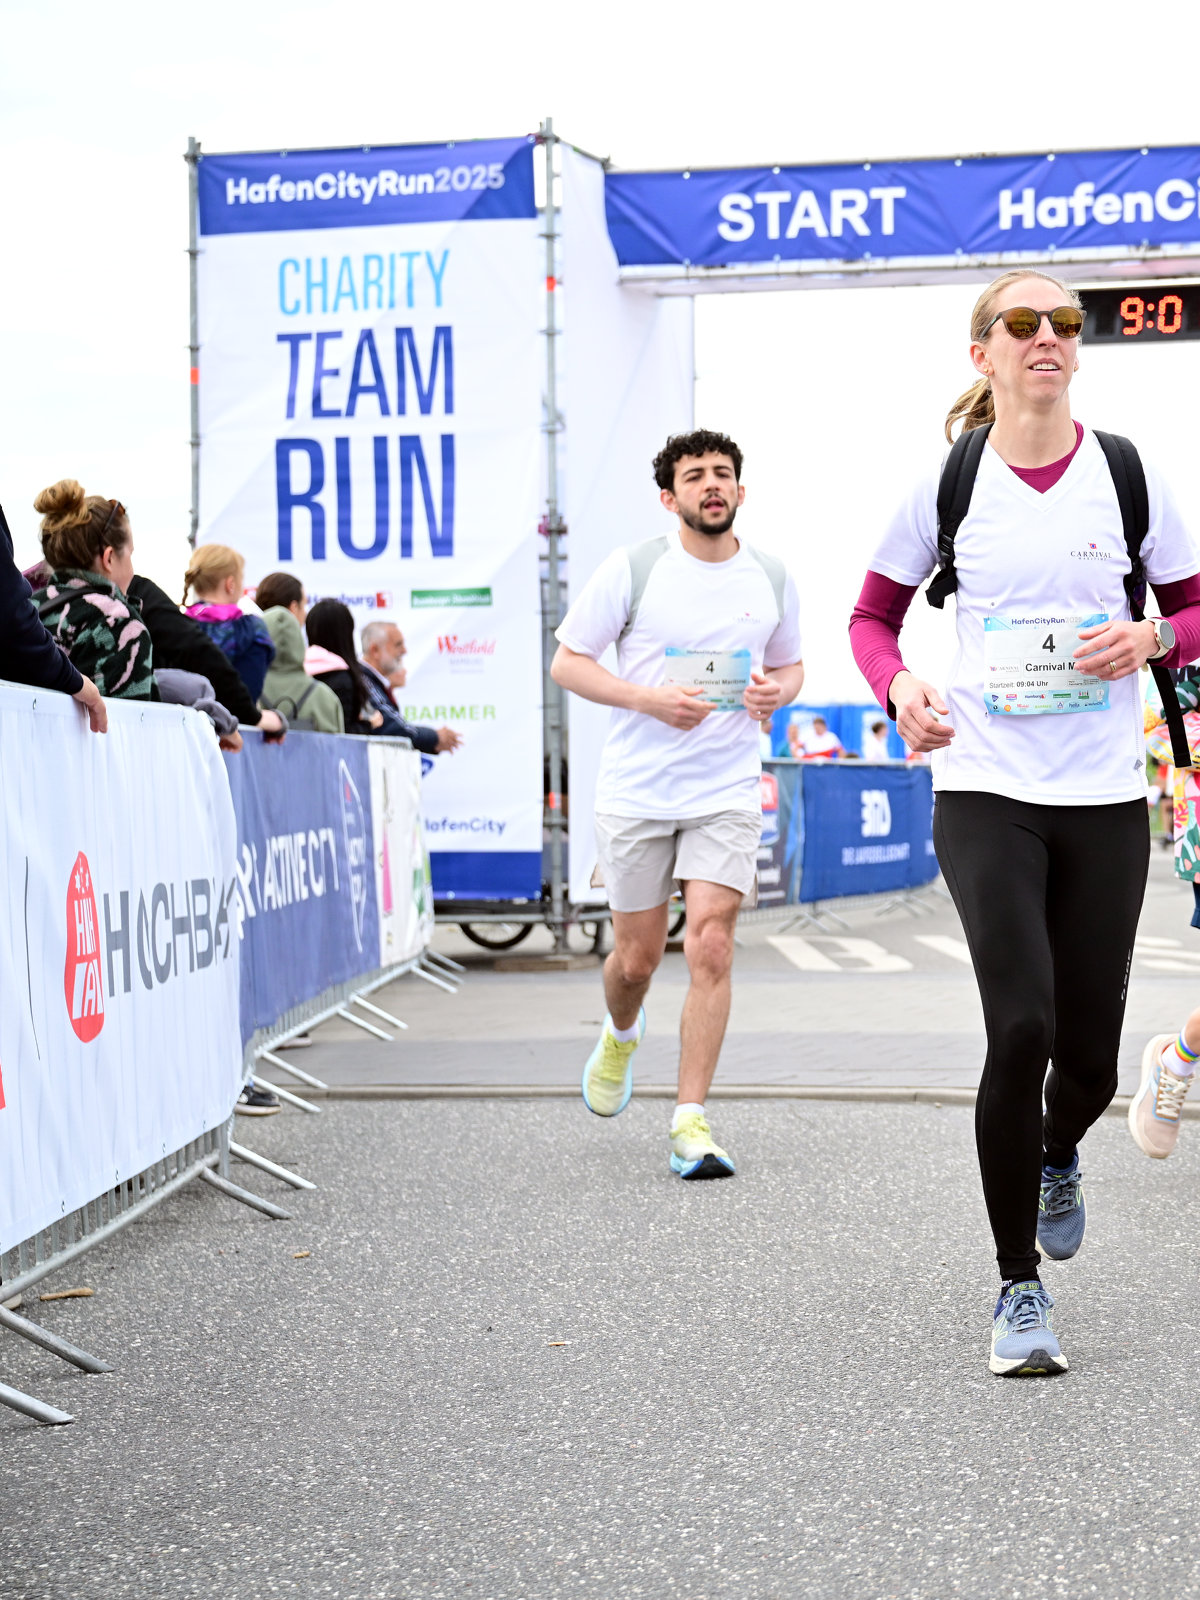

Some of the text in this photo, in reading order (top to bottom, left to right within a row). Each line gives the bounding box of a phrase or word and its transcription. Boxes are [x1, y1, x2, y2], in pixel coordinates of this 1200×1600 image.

[225, 162, 506, 206] HafenCityRun2025
[717, 186, 907, 242] START
[277, 249, 450, 317] CHARITY
[276, 325, 456, 421] TEAM
[274, 433, 456, 562] RUN
[1070, 550, 1112, 559] CARNIVAL
[1041, 633, 1056, 653] 4
[705, 660, 715, 674] 4
[1025, 661, 1066, 672] Carnival
[1016, 680, 1035, 688] 09:04
[1036, 680, 1049, 688] Uhr
[404, 704, 497, 722] BARMER
[425, 817, 507, 836] afenCity
[103, 875, 237, 998] HOCHBA
